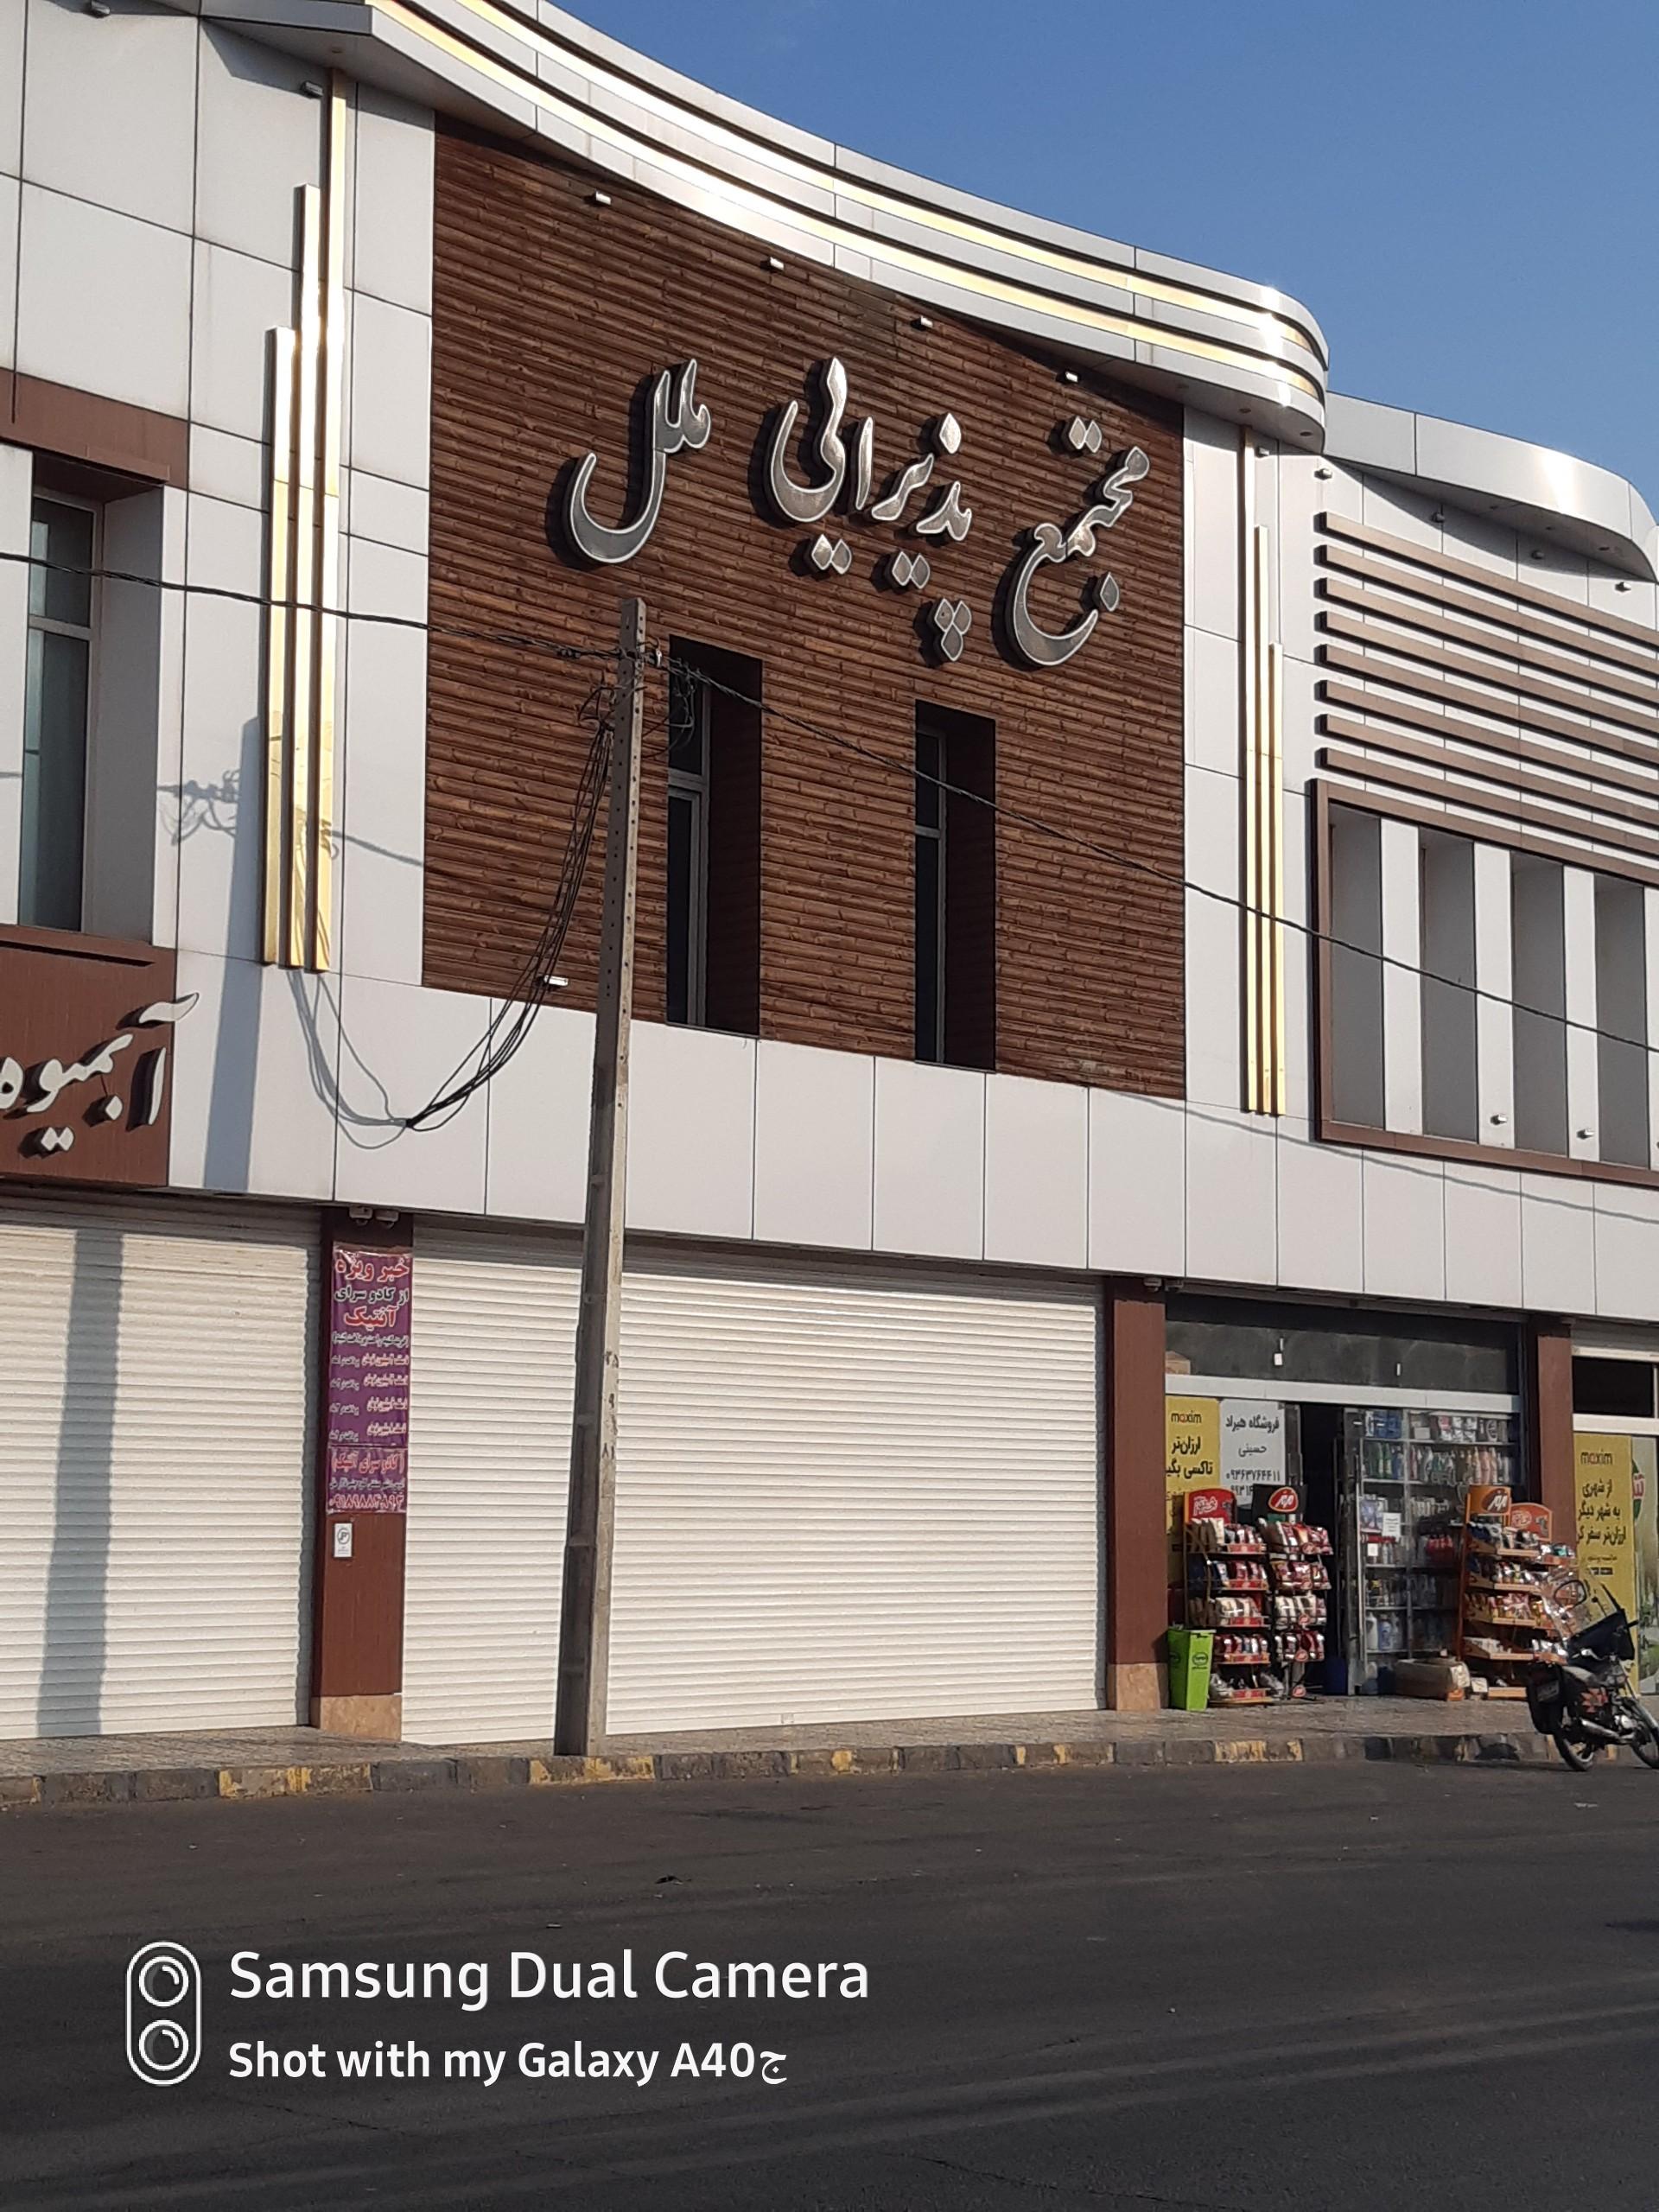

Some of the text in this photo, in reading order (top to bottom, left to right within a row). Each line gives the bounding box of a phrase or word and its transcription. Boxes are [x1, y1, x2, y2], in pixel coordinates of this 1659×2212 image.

[570, 356, 1150, 666] مجتمع پذیرایی ملل
[377, 1258, 410, 1283] خبر
[334, 1284, 367, 1303] سرای
[397, 1288, 410, 1306] از
[343, 1305, 398, 1332] آنتیک
[1171, 1410, 1202, 1424] maxim
[1249, 1414, 1280, 1434] فروشگاه
[1238, 1442, 1268, 1458] حسینی
[1580, 1448, 1613, 1466] maxim
[1184, 1460, 1214, 1479] تاکسی
